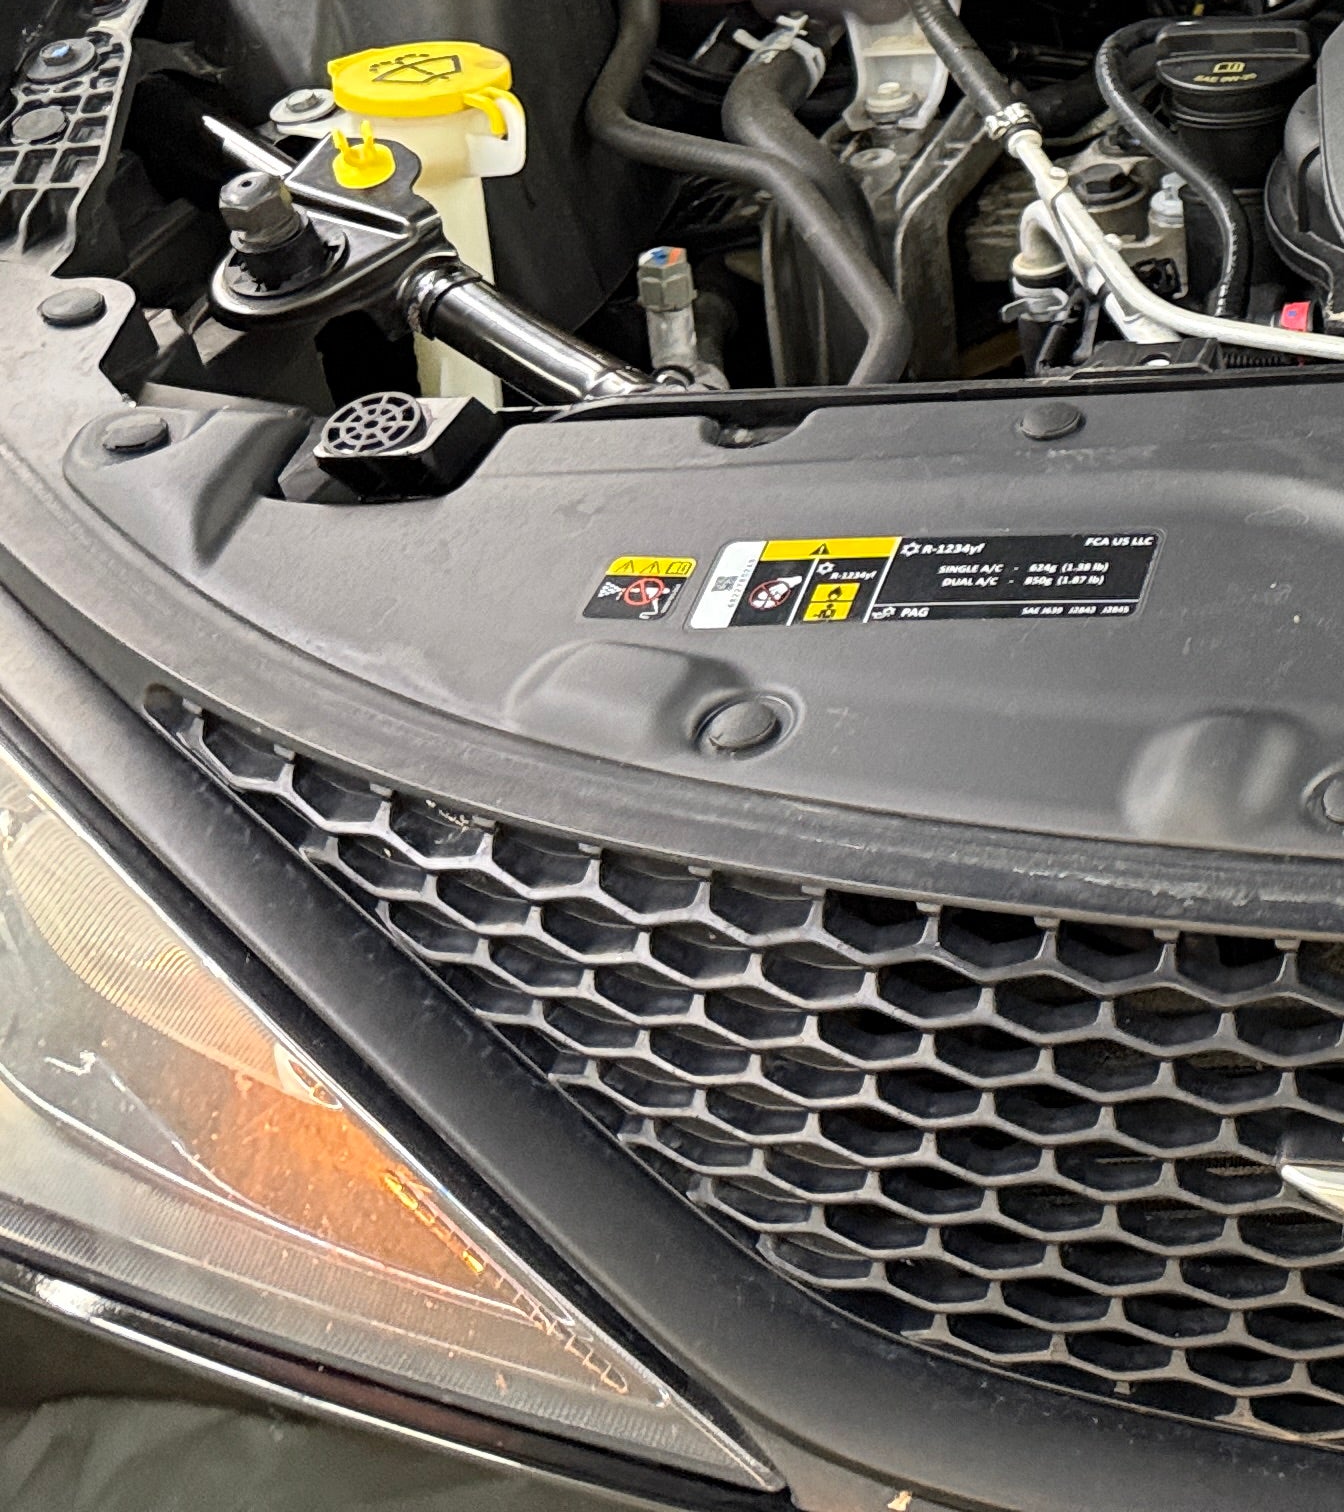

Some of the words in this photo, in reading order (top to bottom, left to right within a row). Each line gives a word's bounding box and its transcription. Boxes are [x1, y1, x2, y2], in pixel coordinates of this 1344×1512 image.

[1193, 75, 1219, 83] SAE
[1085, 537, 1110, 546] FCA
[1111, 537, 1130, 546] US
[1130, 536, 1155, 546] LLC
[921, 543, 985, 556] R-1234yf
[938, 564, 979, 573] SINGLE
[980, 563, 1004, 574] A/C
[1028, 563, 1059, 574] 624g
[1092, 562, 1110, 573] lb)
[830, 571, 877, 580] R-1234yf
[942, 577, 974, 586] DUAL
[975, 576, 999, 587] A/C
[1087, 575, 1105, 586] lb)
[900, 607, 929, 618] PAG
[1021, 606, 1041, 615] SAE
